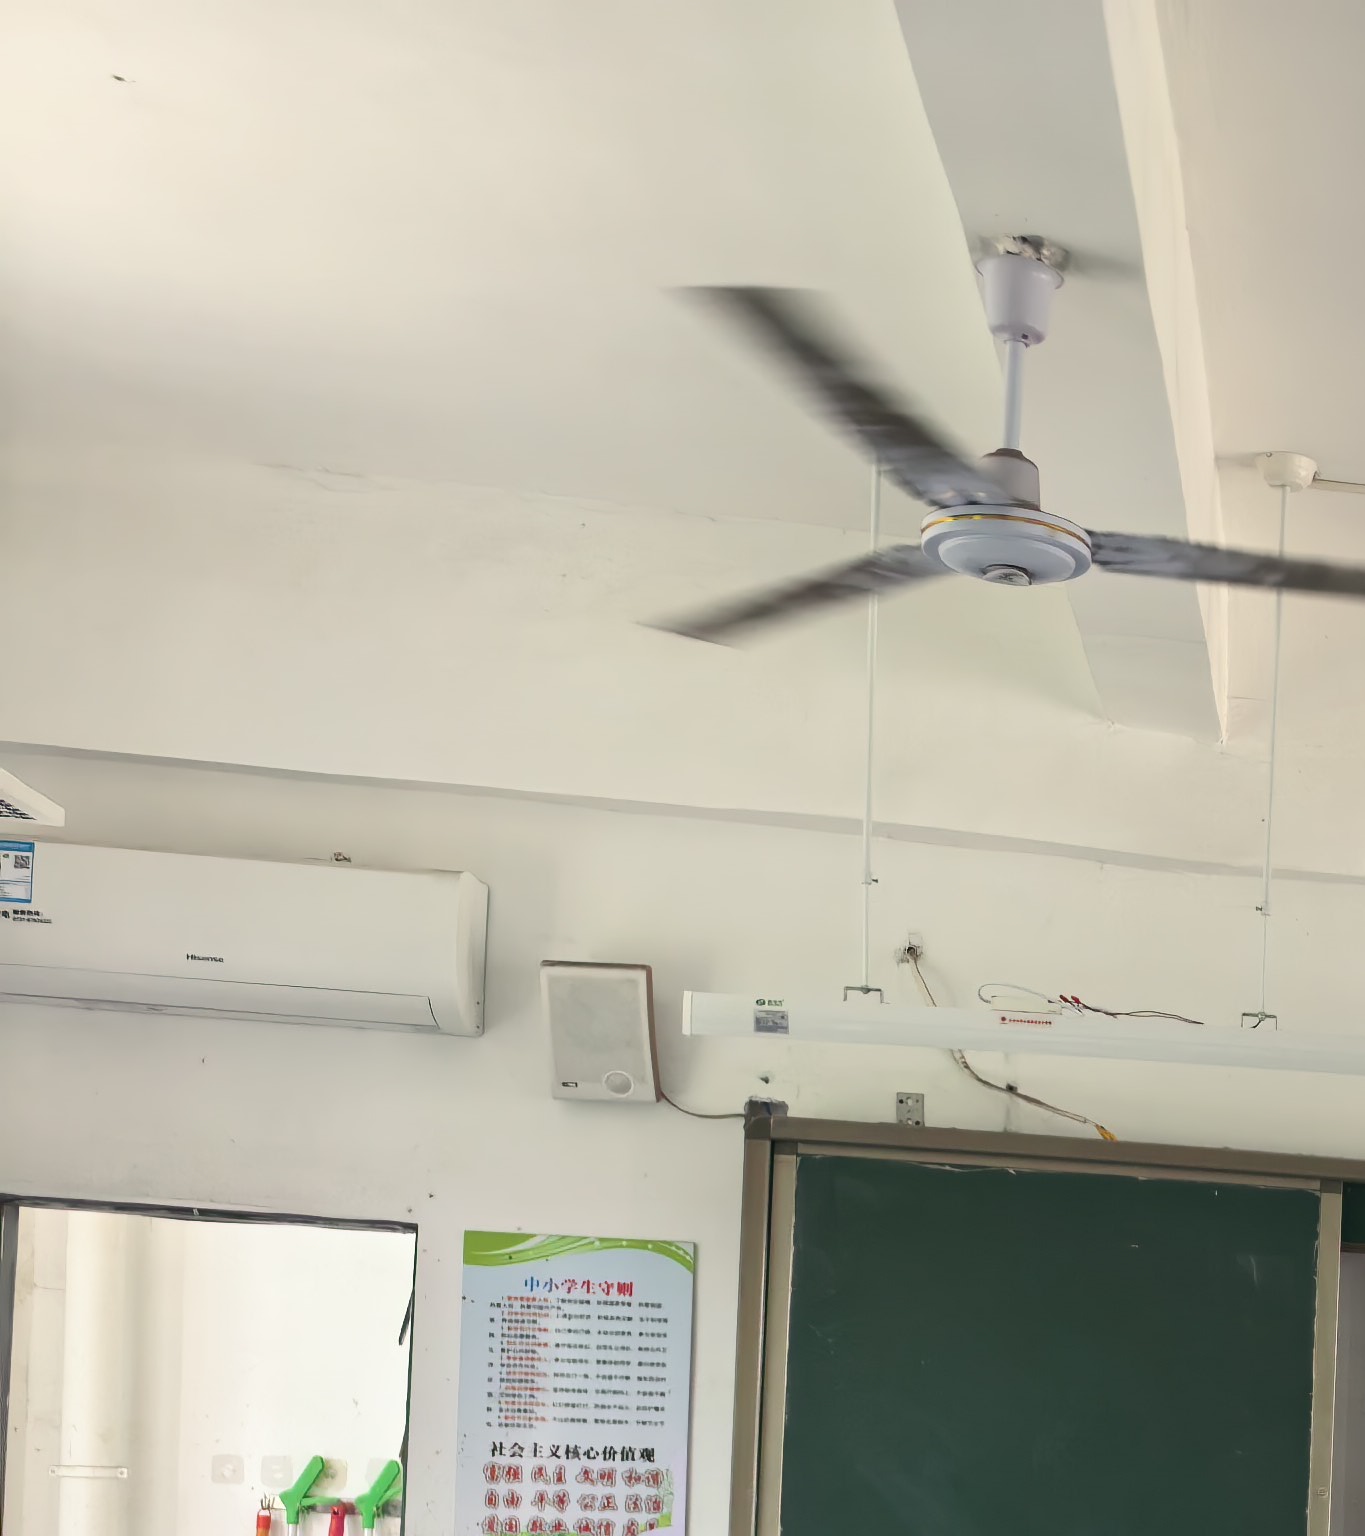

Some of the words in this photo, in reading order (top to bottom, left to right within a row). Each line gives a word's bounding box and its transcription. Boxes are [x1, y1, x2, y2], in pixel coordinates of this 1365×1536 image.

[524, 1276, 634, 1297] 中小学生守则
[491, 1441, 656, 1462] 社会主义核心价值观
